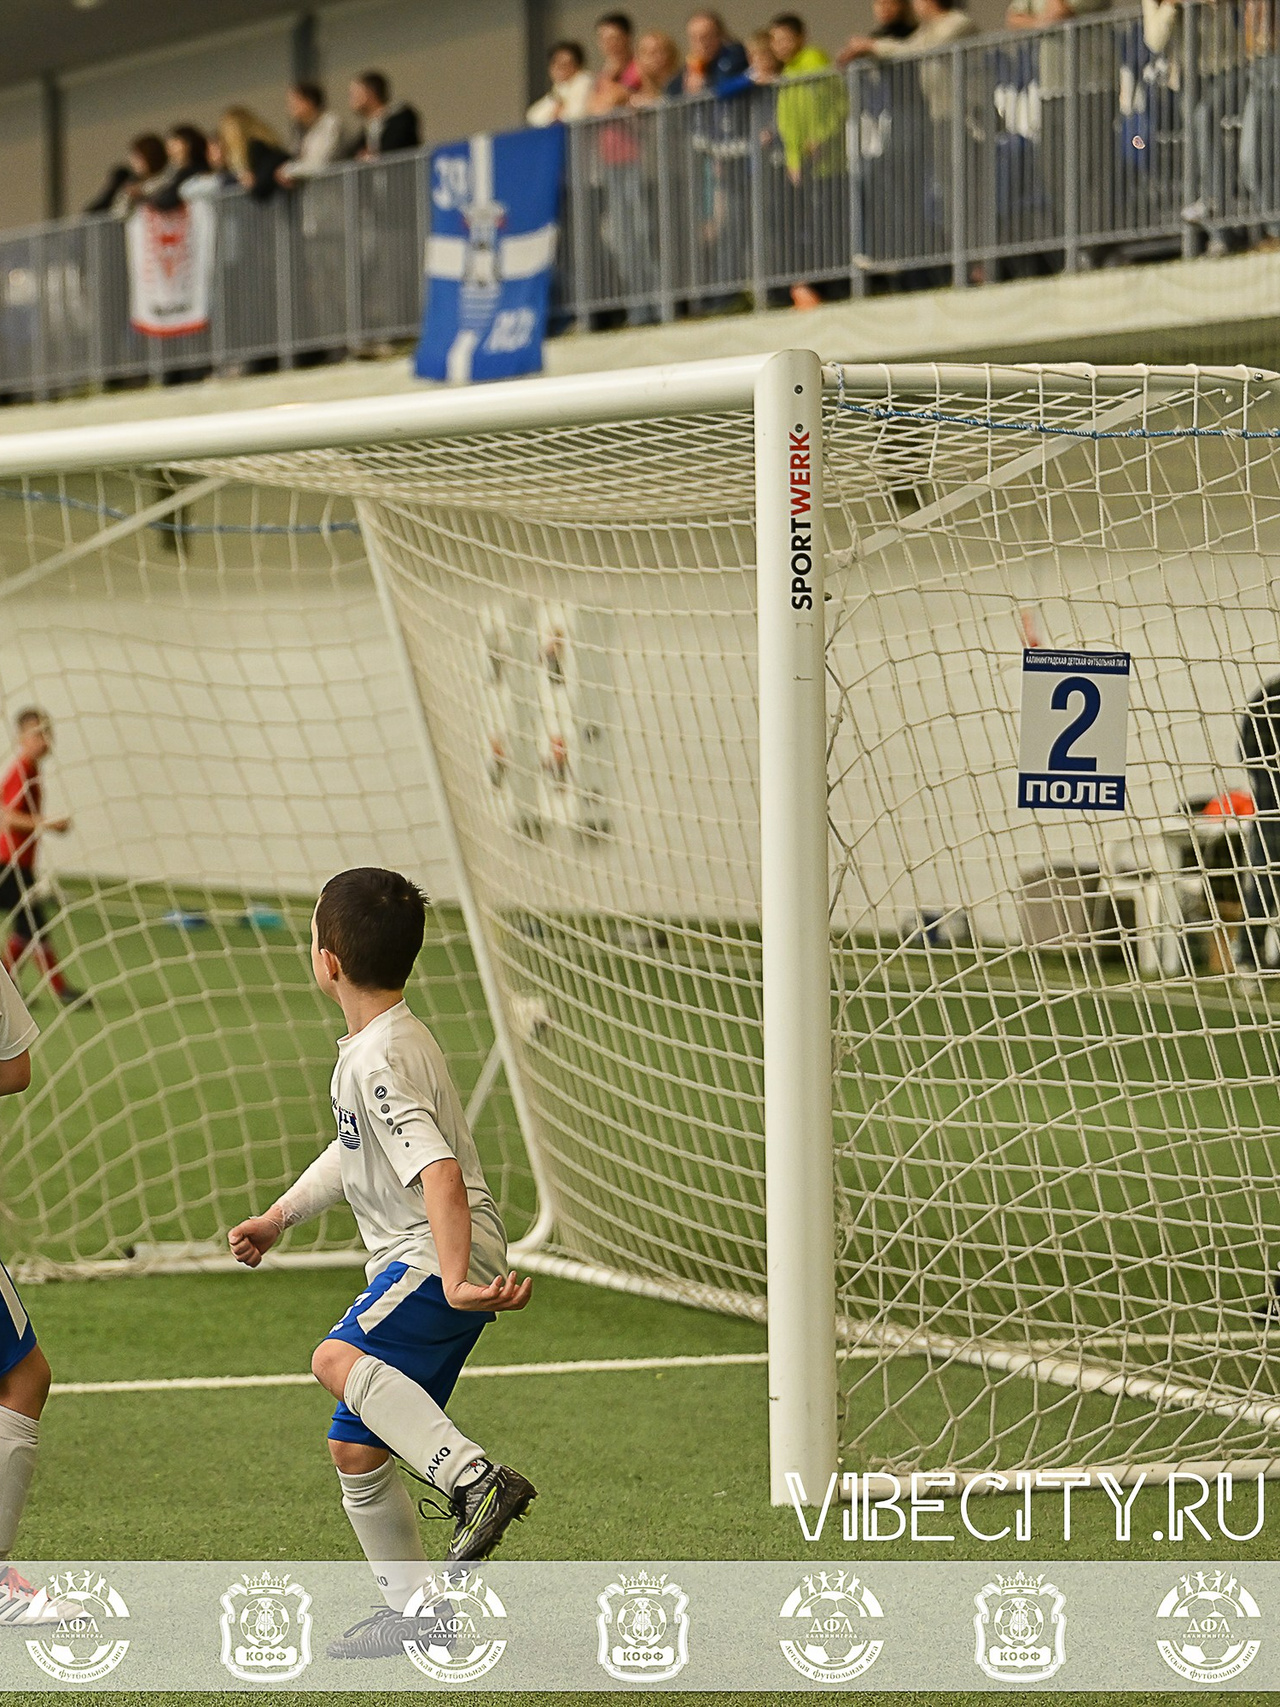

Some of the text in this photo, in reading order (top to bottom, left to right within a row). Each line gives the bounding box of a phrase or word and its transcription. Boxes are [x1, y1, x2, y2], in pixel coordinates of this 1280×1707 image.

[788, 431, 812, 611] SPORTWERK
[1067, 657, 1086, 666] ДЕТСКАЯ
[1048, 676, 1101, 772] 2
[1025, 780, 1118, 804] ПОЛЕ
[425, 1446, 451, 1486] JAKO
